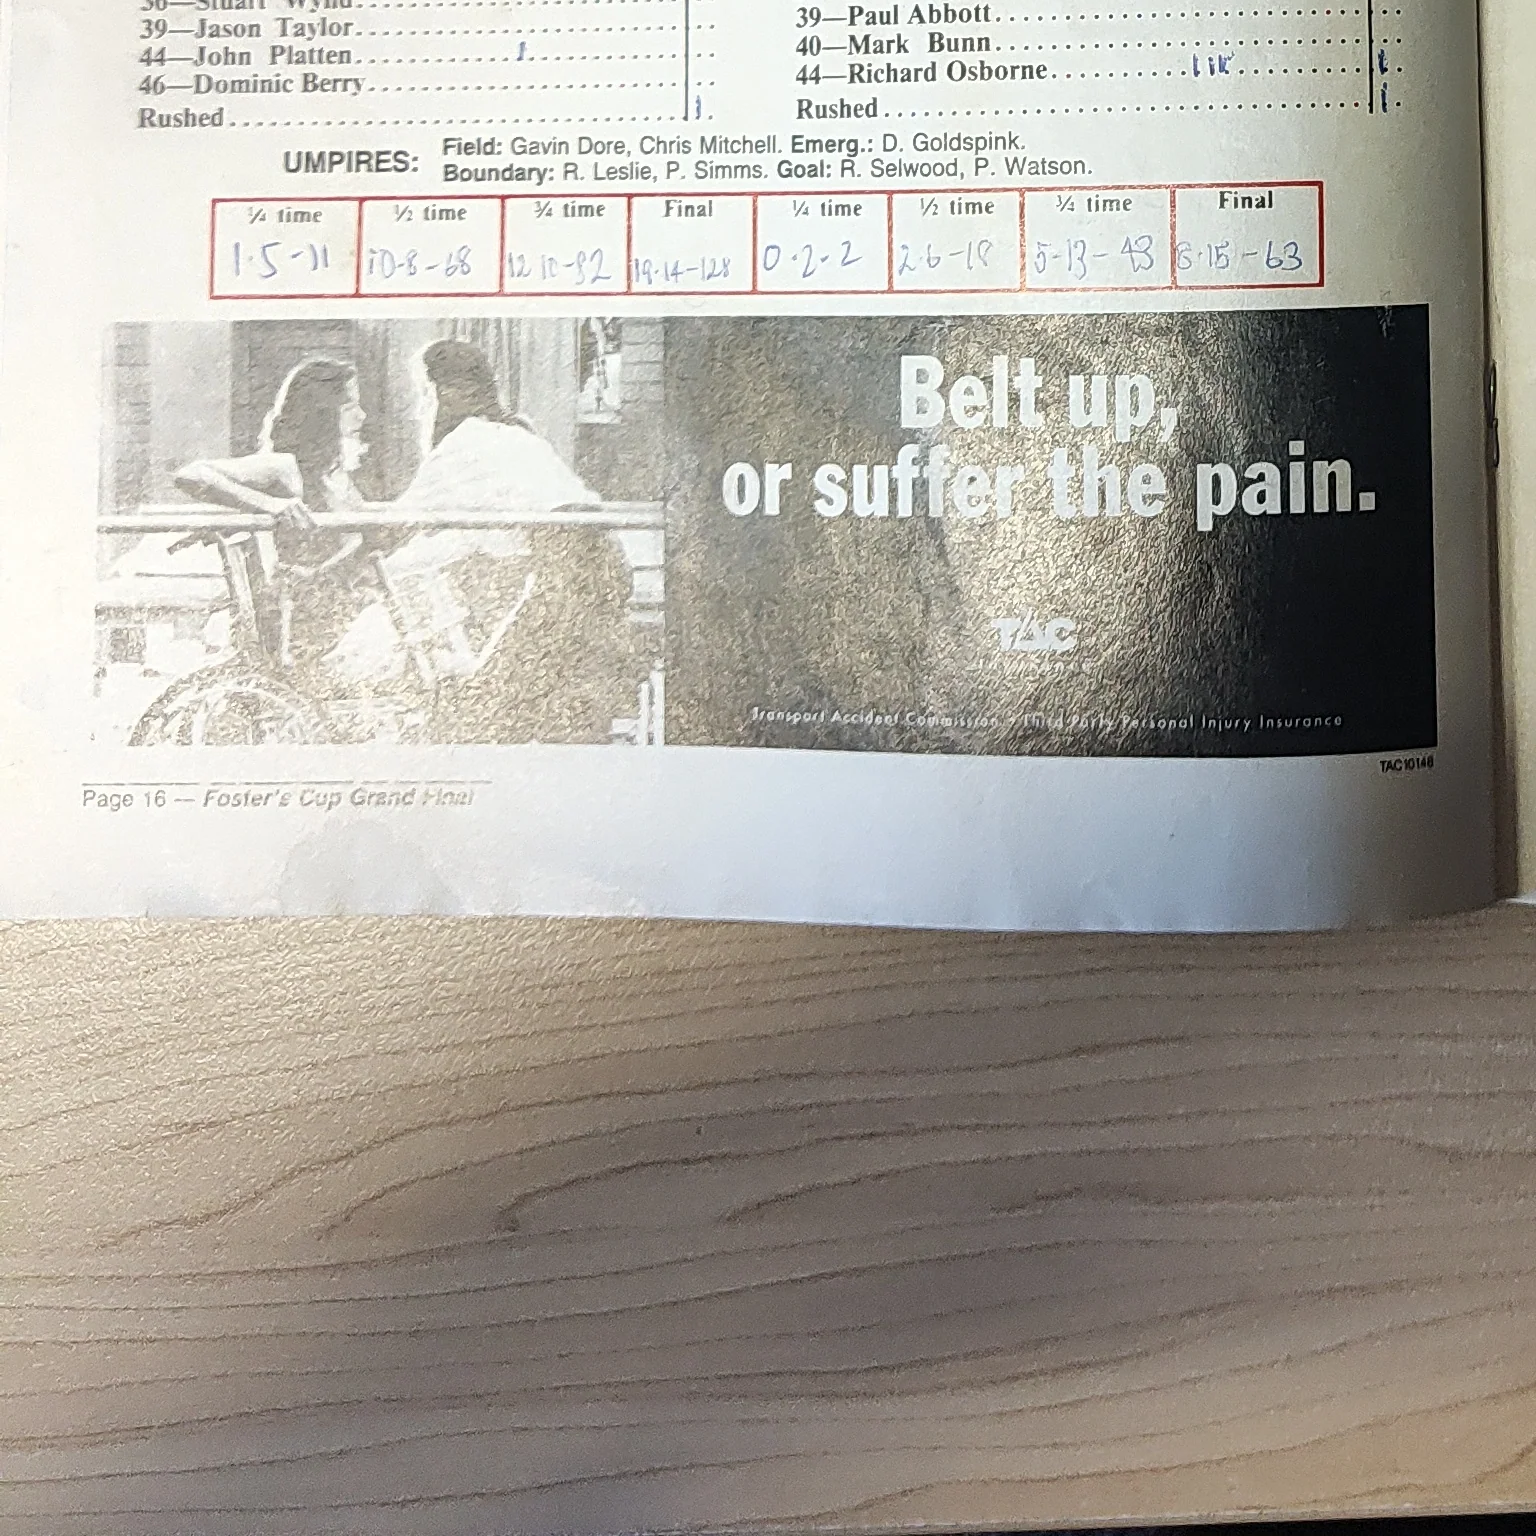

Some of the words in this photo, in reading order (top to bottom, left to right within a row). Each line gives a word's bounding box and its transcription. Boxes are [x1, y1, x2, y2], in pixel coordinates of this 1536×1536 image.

[442, 136, 503, 157] Field:
[512, 136, 569, 156] Gavin
[578, 136, 631, 159] Dore,
[640, 135, 692, 155] Chris
[700, 135, 783, 155] Mitchell.
[792, 134, 873, 158] Emerg.:
[883, 134, 904, 153] D.
[913, 131, 1026, 156] Goldspink.
[283, 149, 419, 174] UMPIRES:
[443, 163, 555, 187] Boundary:
[564, 162, 585, 181] R.
[594, 161, 658, 183] Leslie,
[666, 161, 686, 180] P.
[695, 160, 769, 180] Simms.
[777, 159, 832, 179] Goal:
[841, 159, 862, 178] R.
[871, 157, 965, 181] Selwood,
[975, 158, 996, 177] P.
[1005, 156, 1093, 177] Watson.
[664, 199, 713, 219] Final
[1219, 191, 1274, 211] Final
[900, 354, 1045, 429] Belt
[1068, 368, 1179, 444] up,
[722, 462, 792, 517] or
[812, 444, 1024, 519] suffer
[1050, 445, 1167, 519] the
[1195, 439, 1377, 531] pain.
[994, 614, 1077, 652] TAC
[1121, 716, 1194, 730] Personal
[1201, 715, 1251, 732] Injury
[1259, 714, 1343, 729] Insurance
[82, 790, 134, 809] Page
[144, 790, 167, 808] 16
[299, 790, 338, 810] Cup
[350, 787, 417, 807] Grand
